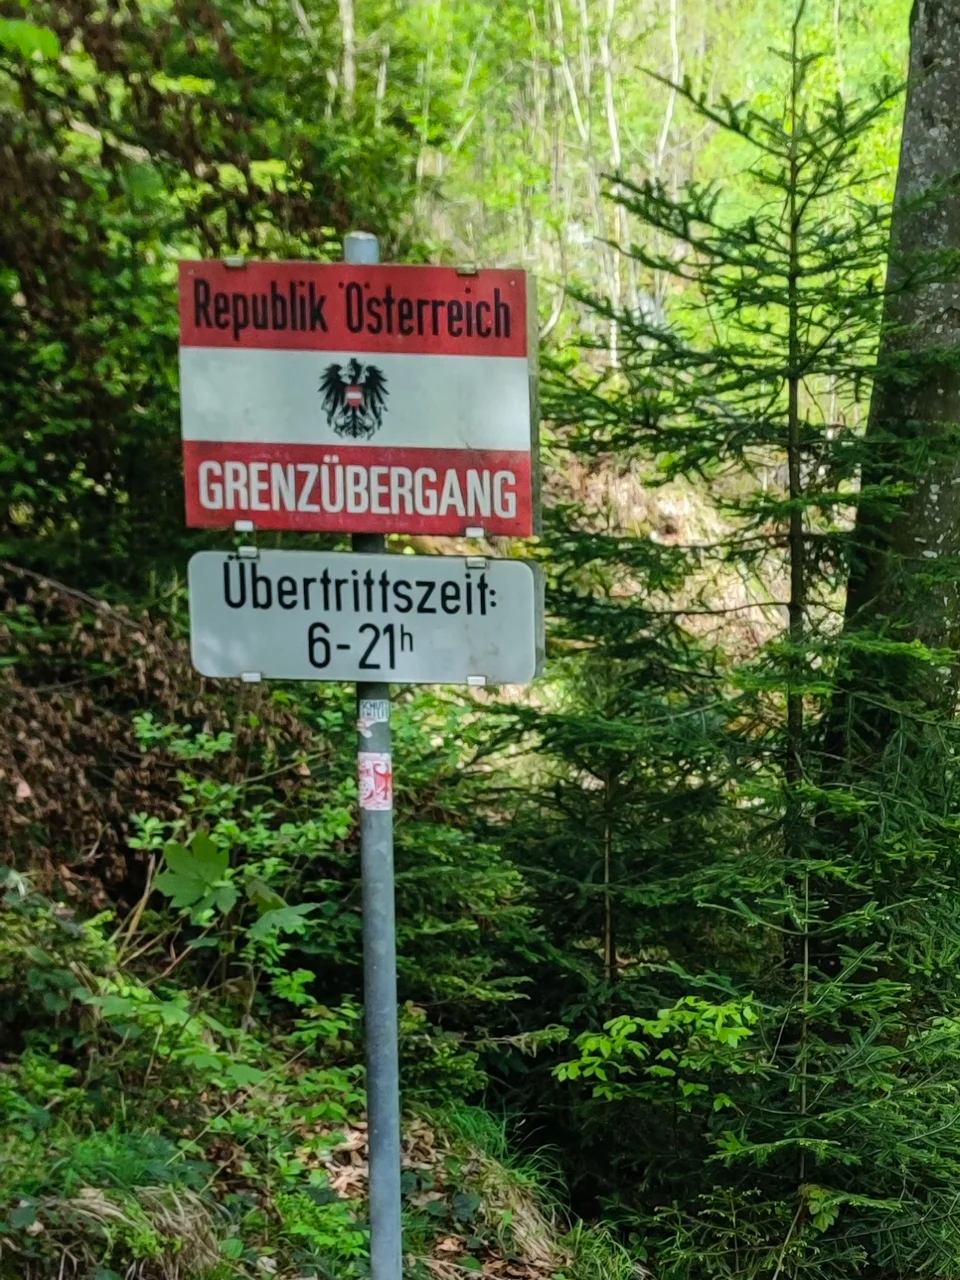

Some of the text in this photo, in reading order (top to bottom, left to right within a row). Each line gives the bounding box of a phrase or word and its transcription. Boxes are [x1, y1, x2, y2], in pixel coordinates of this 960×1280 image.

[194, 279, 512, 341] Republik Österreich
[199, 455, 517, 518] GRENZÜBERGANG
[223, 555, 497, 615] Übertrittszeit:
